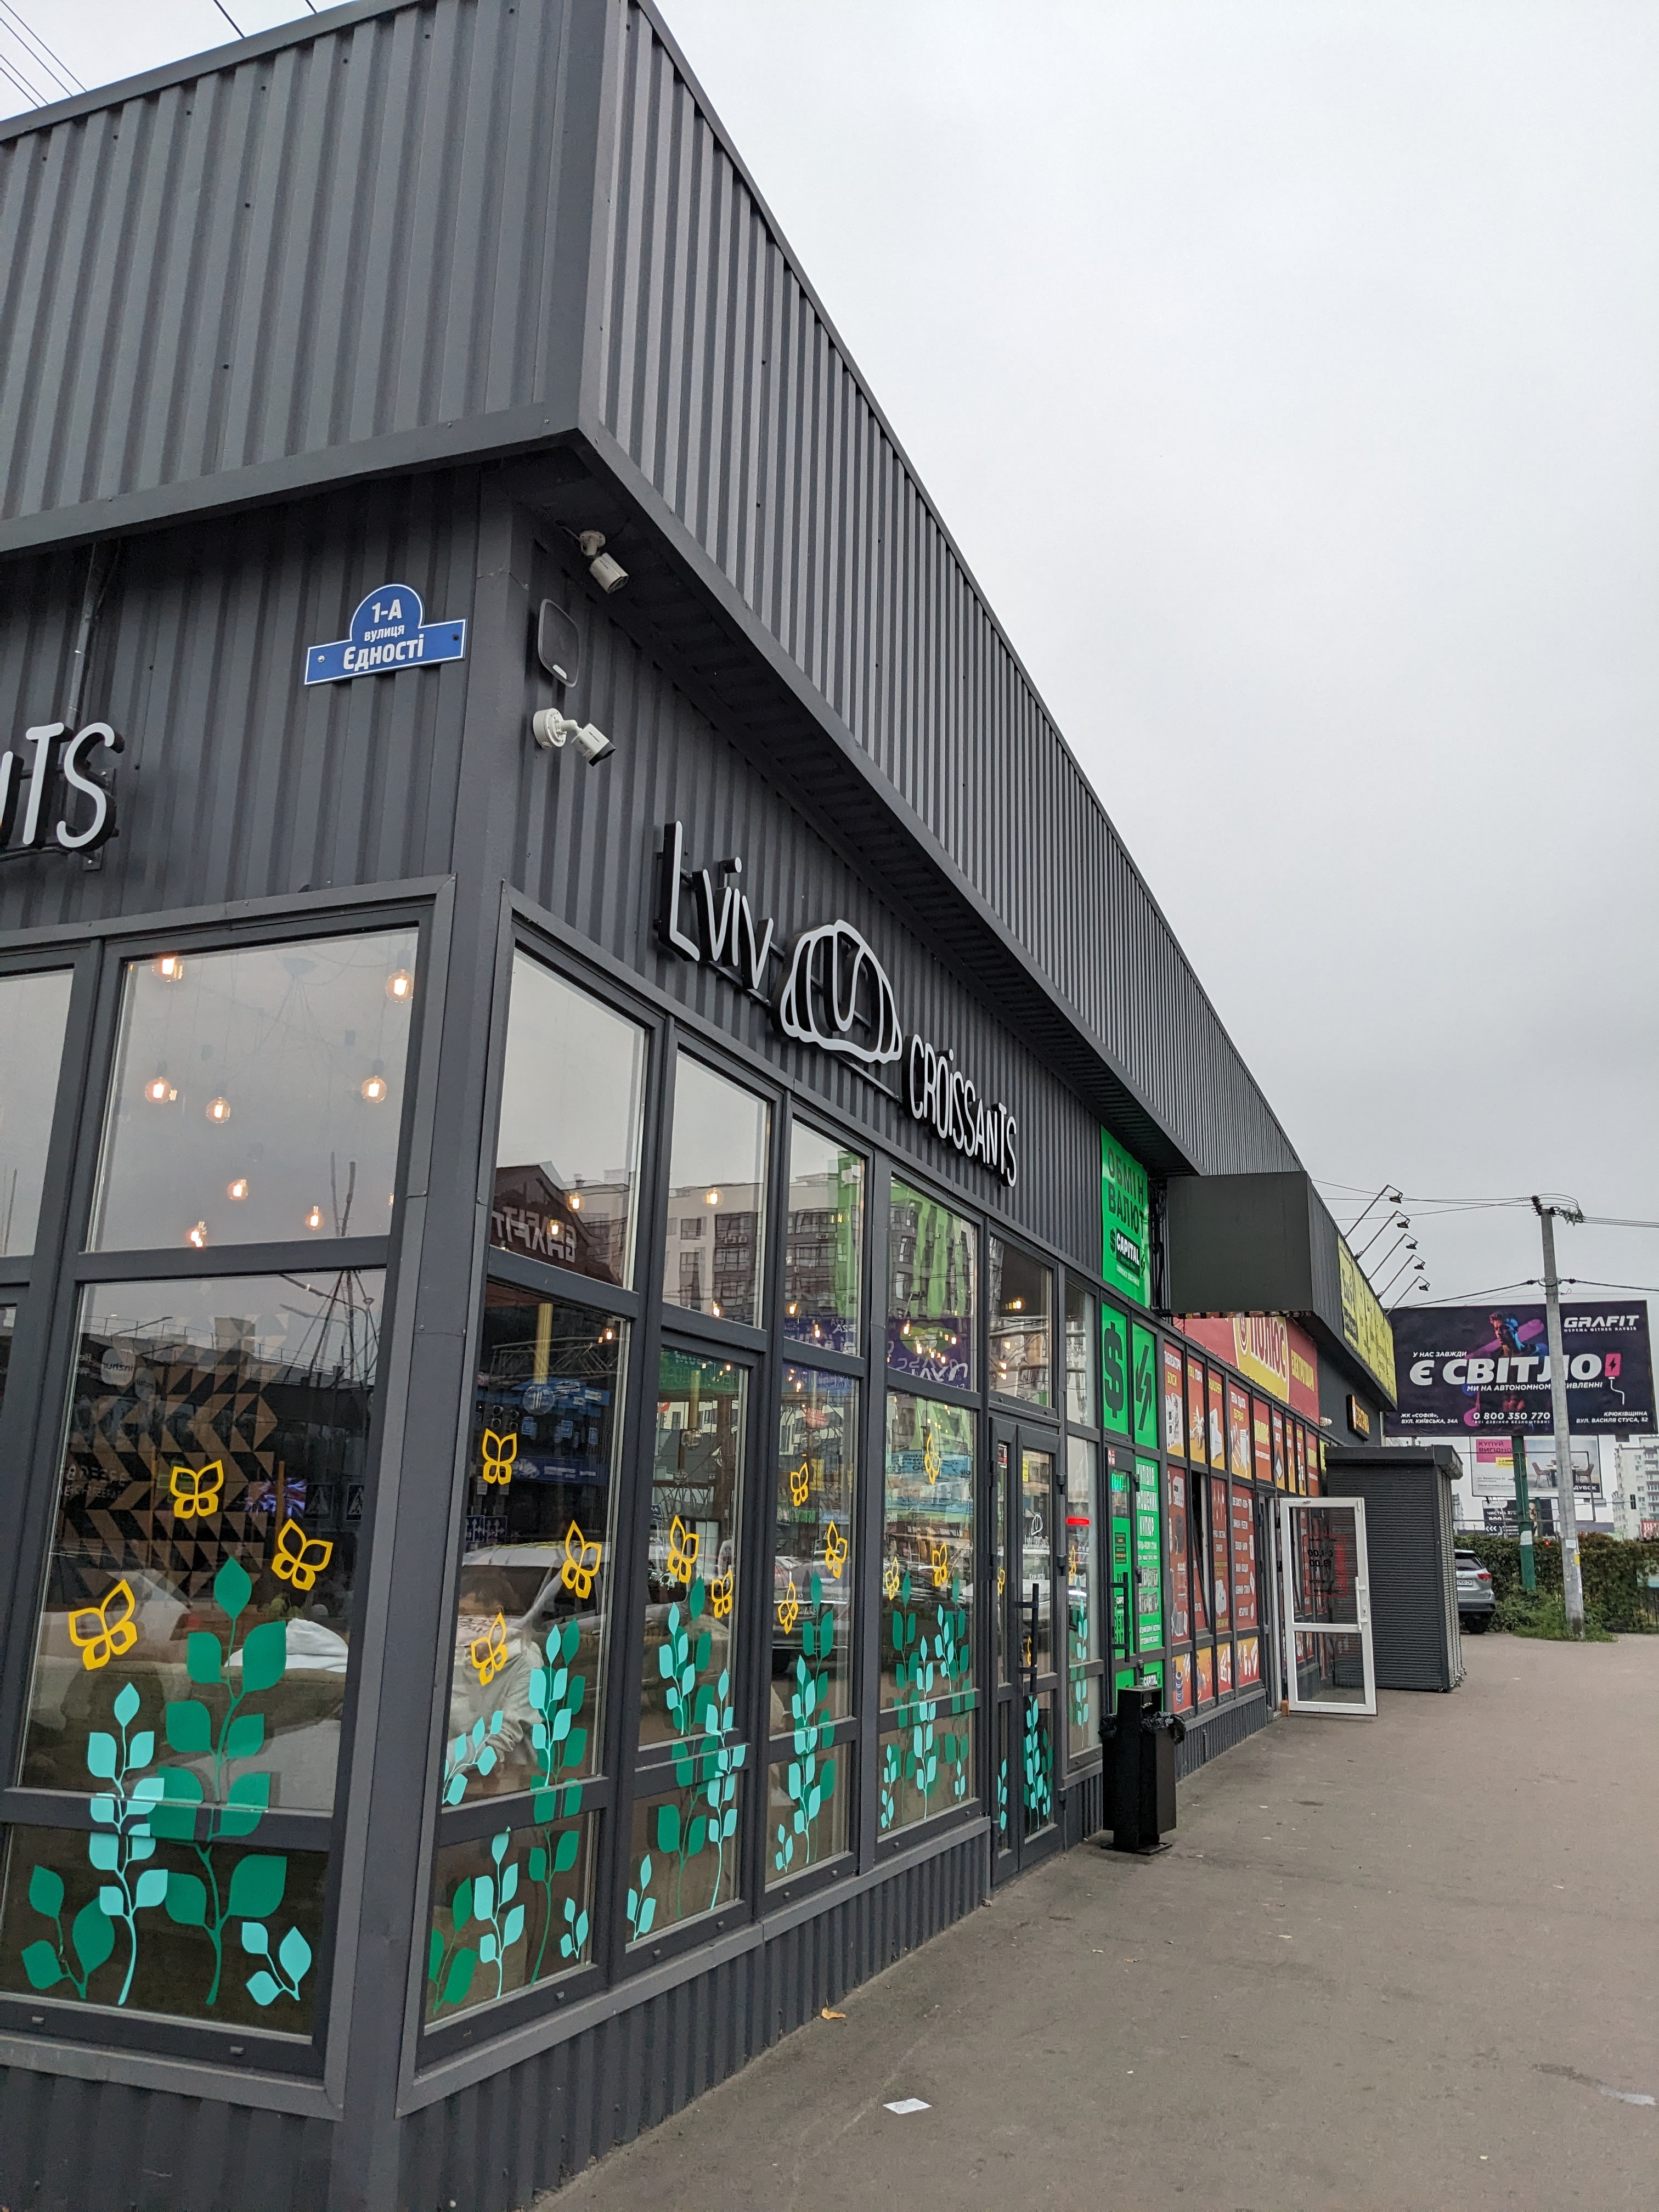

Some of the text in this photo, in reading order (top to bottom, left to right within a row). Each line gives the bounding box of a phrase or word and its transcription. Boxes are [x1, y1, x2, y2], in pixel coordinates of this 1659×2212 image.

[364, 624, 405, 642] вулиця
[343, 634, 424, 672] Єдності
[1108, 1147, 1144, 1207] ОБМІН
[1108, 1182, 1144, 1239] ВАЛЮТ
[1116, 1233, 1140, 1266] CAPITAL
[1564, 1315, 1639, 1328] GRAFIT
[1409, 1359, 1435, 1386] Є
